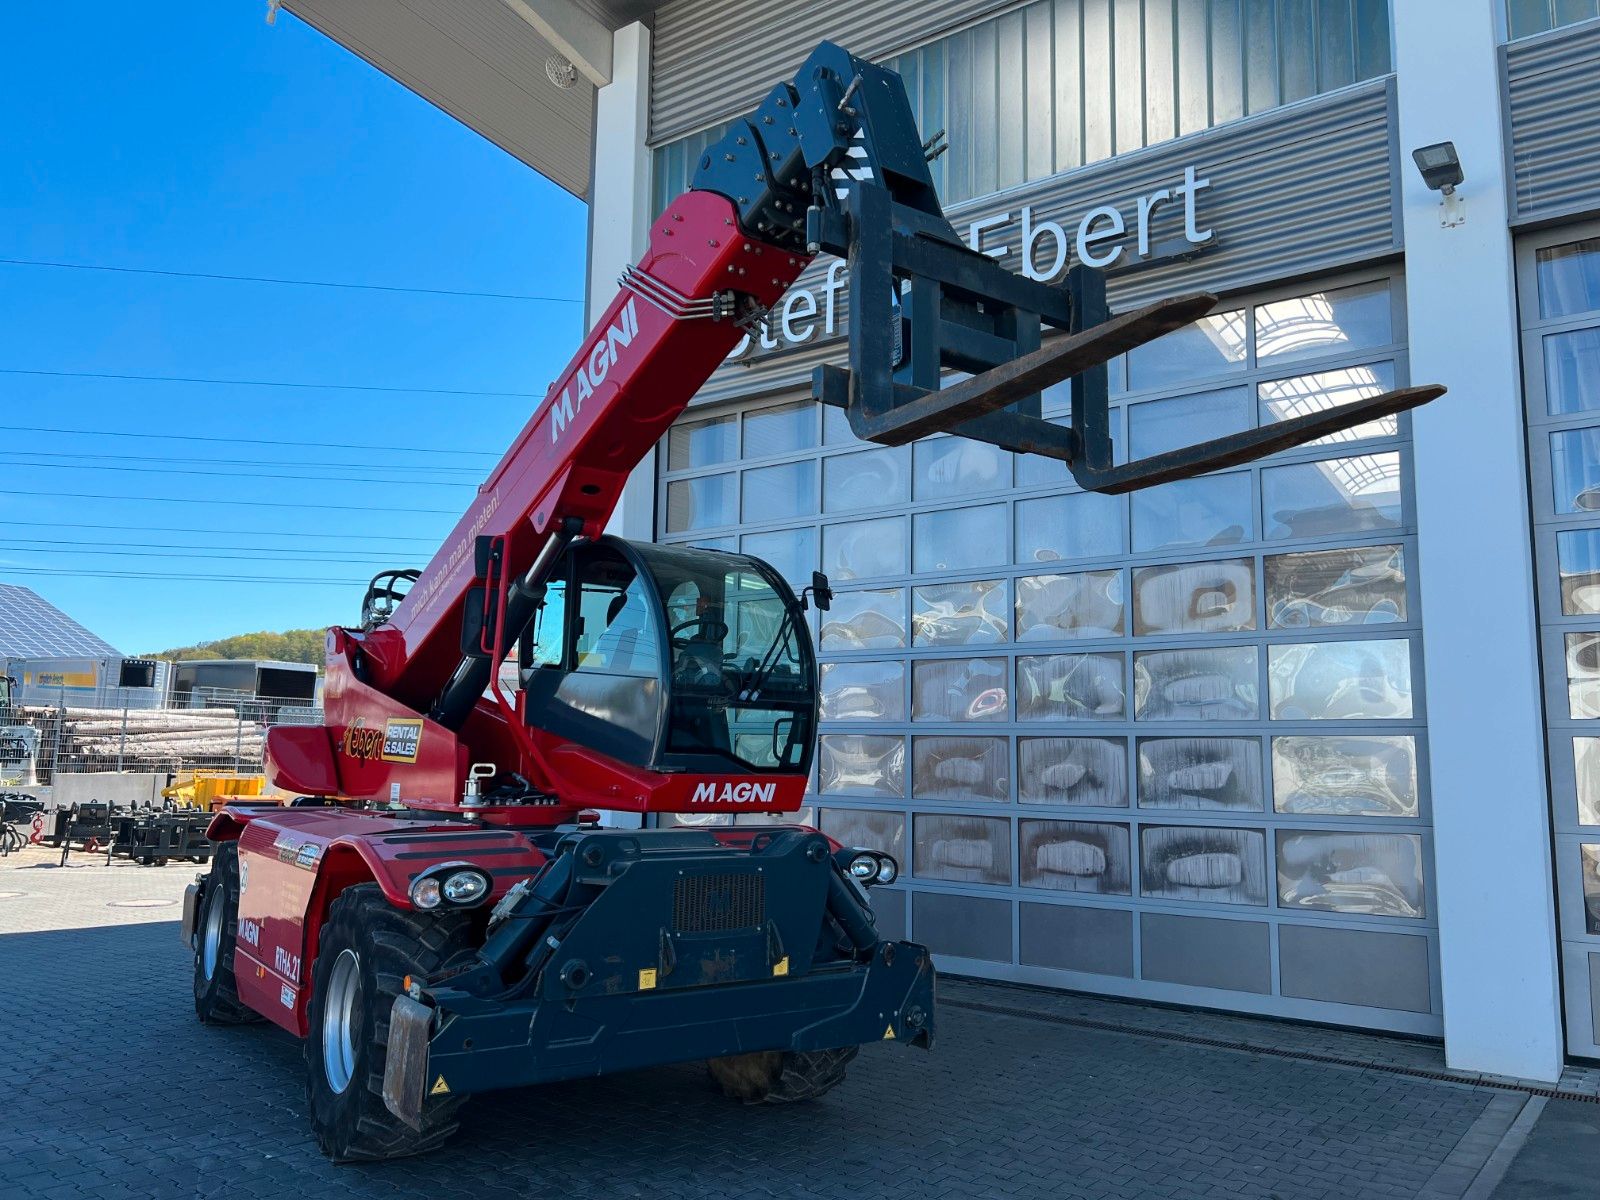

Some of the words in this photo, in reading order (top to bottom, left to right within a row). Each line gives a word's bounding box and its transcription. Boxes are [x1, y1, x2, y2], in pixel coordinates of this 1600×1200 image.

[970, 165, 1213, 282] Ebert
[551, 296, 639, 444] MAGNI
[429, 564, 448, 594] kann
[449, 538, 467, 570] man
[468, 486, 500, 544] mieten!
[387, 725, 418, 740] RENTAL
[691, 782, 776, 803] MAGNI
[239, 917, 260, 948] MAGNI
[275, 945, 301, 984] RTH6.21
